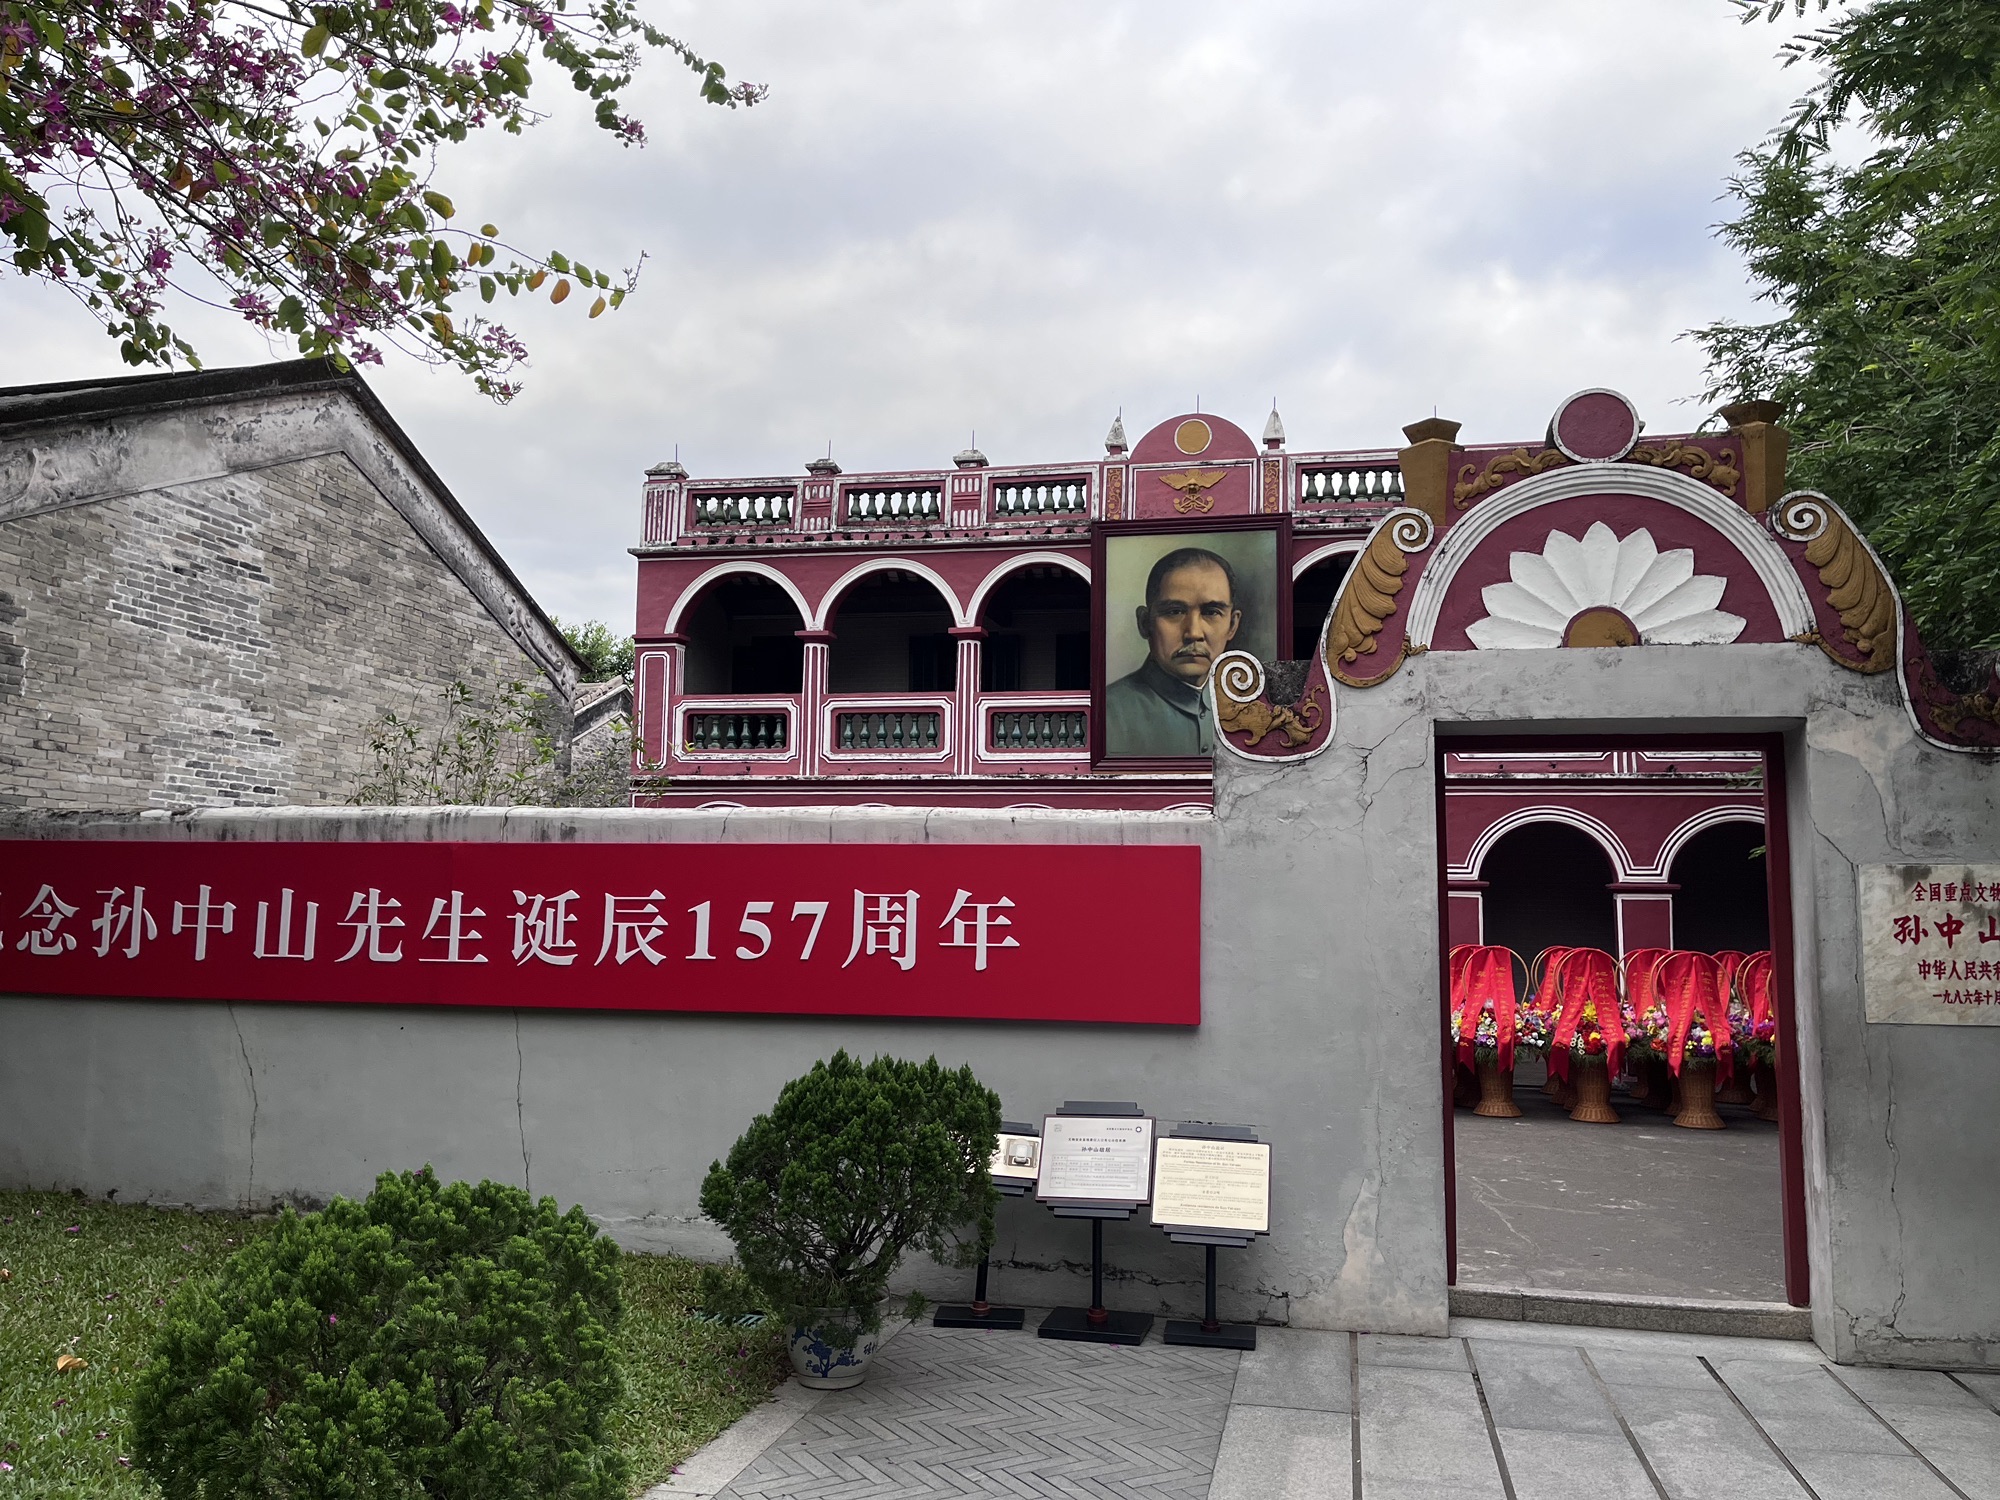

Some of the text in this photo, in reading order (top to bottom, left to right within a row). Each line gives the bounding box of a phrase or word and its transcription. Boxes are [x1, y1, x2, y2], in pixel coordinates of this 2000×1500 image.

[1911, 881, 2000, 903] 全国重点文物
[0, 884, 1020, 971] 念孙中山先生诞辰157周年
[1893, 912, 2000, 950] 孙中山
